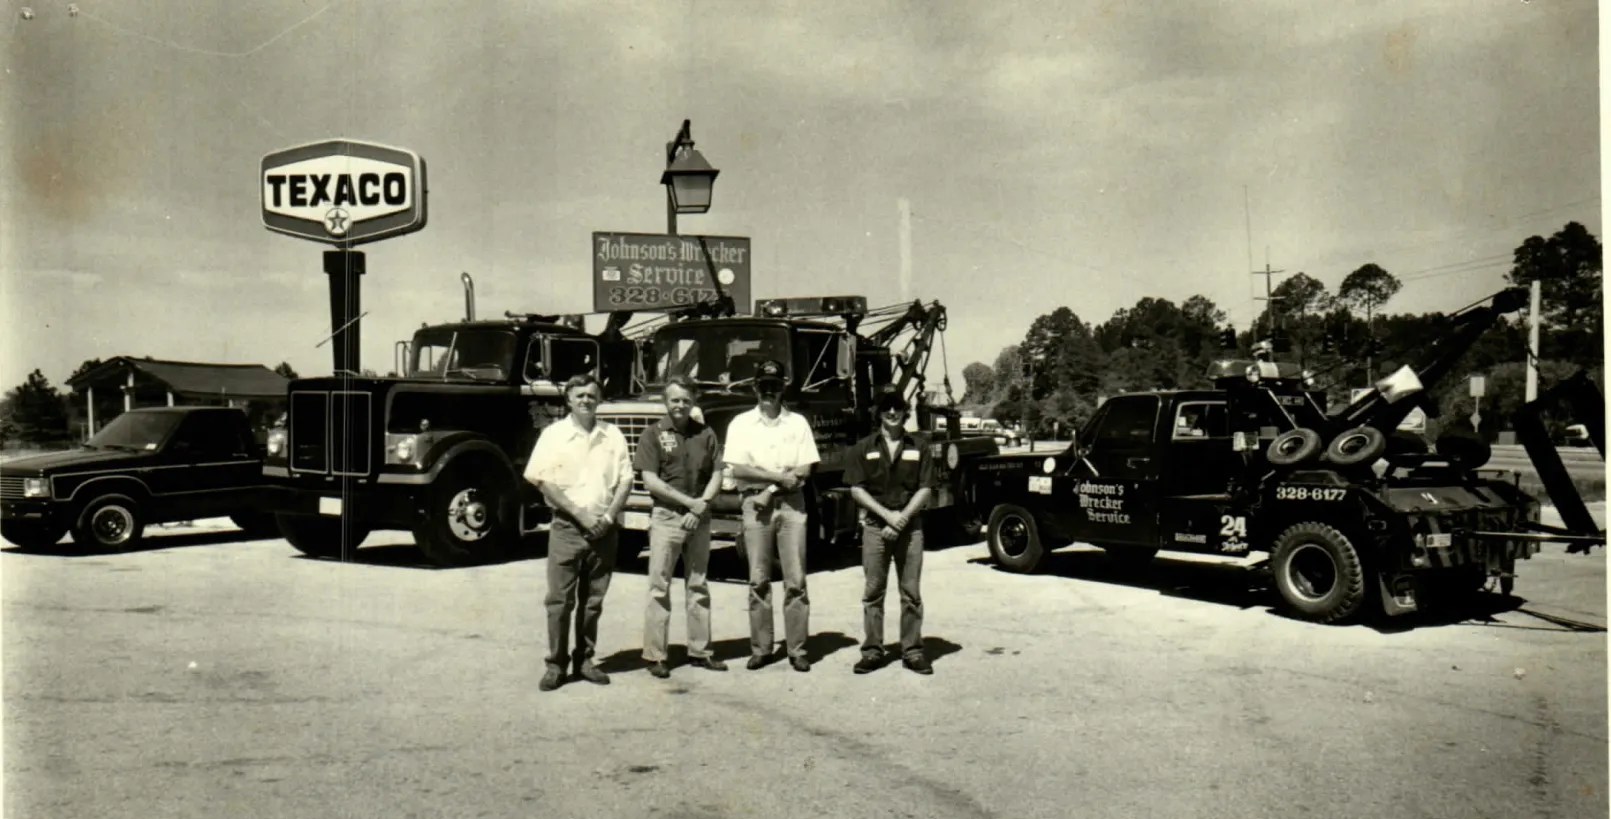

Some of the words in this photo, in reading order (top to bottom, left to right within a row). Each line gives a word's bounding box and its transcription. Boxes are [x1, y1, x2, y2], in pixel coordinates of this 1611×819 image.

[267, 172, 406, 207] TEXACO
[597, 237, 677, 261] Johnson's
[680, 240, 746, 264] Wrcker
[627, 263, 705, 285] Service
[609, 286, 731, 305] 328-617
[1072, 478, 1125, 496] Johnson's
[1276, 486, 1347, 501] 328-6177
[1079, 493, 1124, 511] Wrecker
[1086, 508, 1132, 525] Service
[1219, 514, 1248, 537] 24
